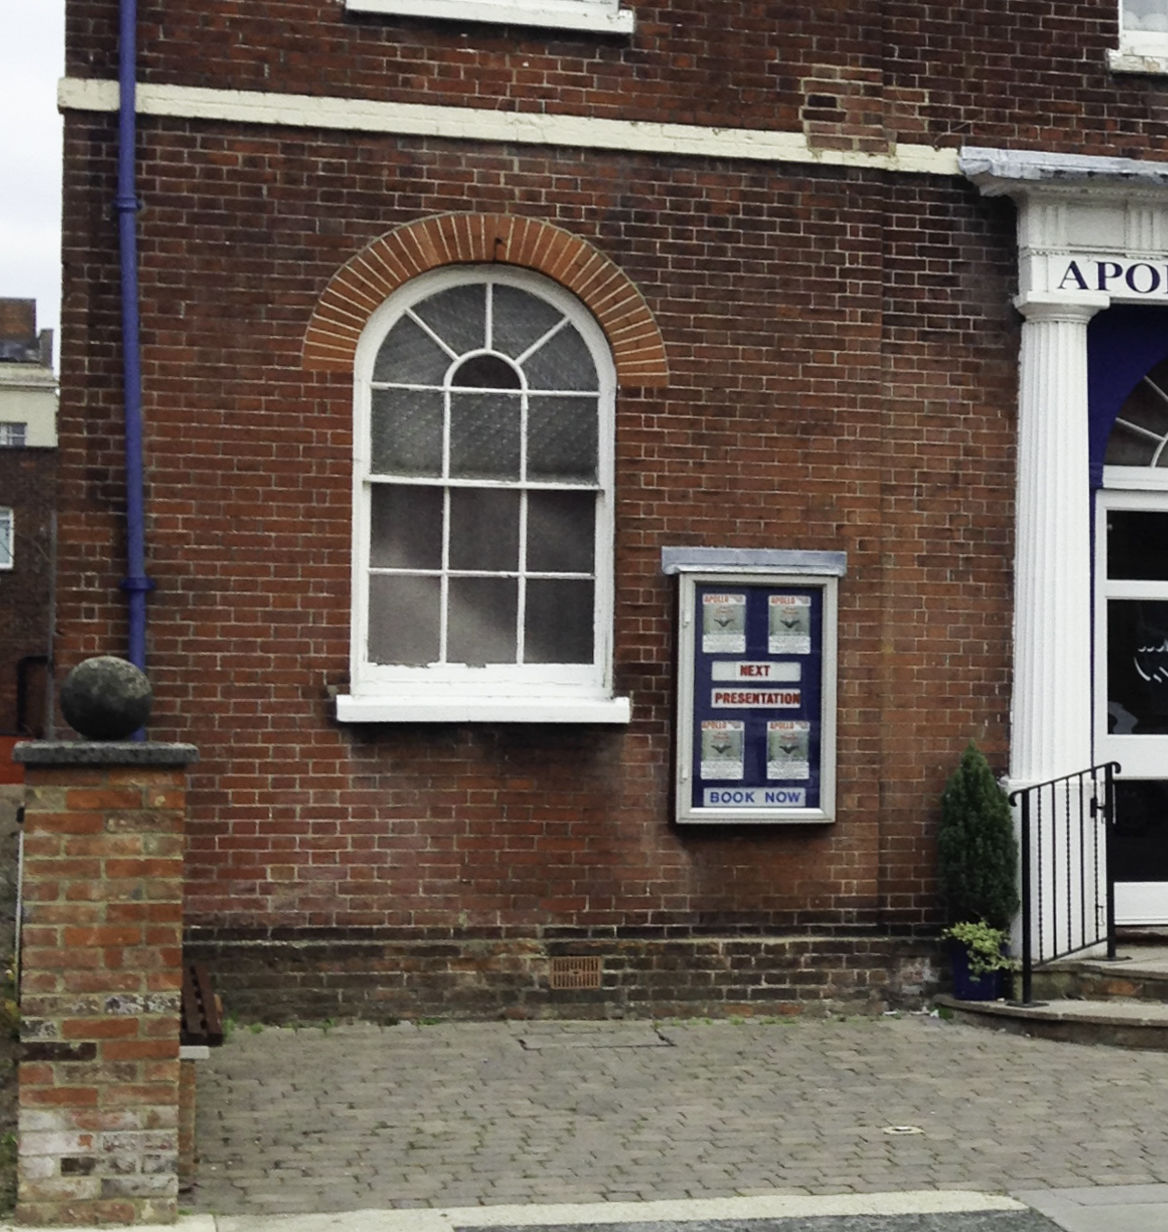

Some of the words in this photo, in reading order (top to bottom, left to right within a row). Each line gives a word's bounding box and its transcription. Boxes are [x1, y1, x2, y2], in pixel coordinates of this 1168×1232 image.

[740, 664, 771, 677] NEXT
[715, 692, 800, 705] PRESENTATION
[710, 791, 755, 803] BOOK
[765, 791, 801, 803] NOW
